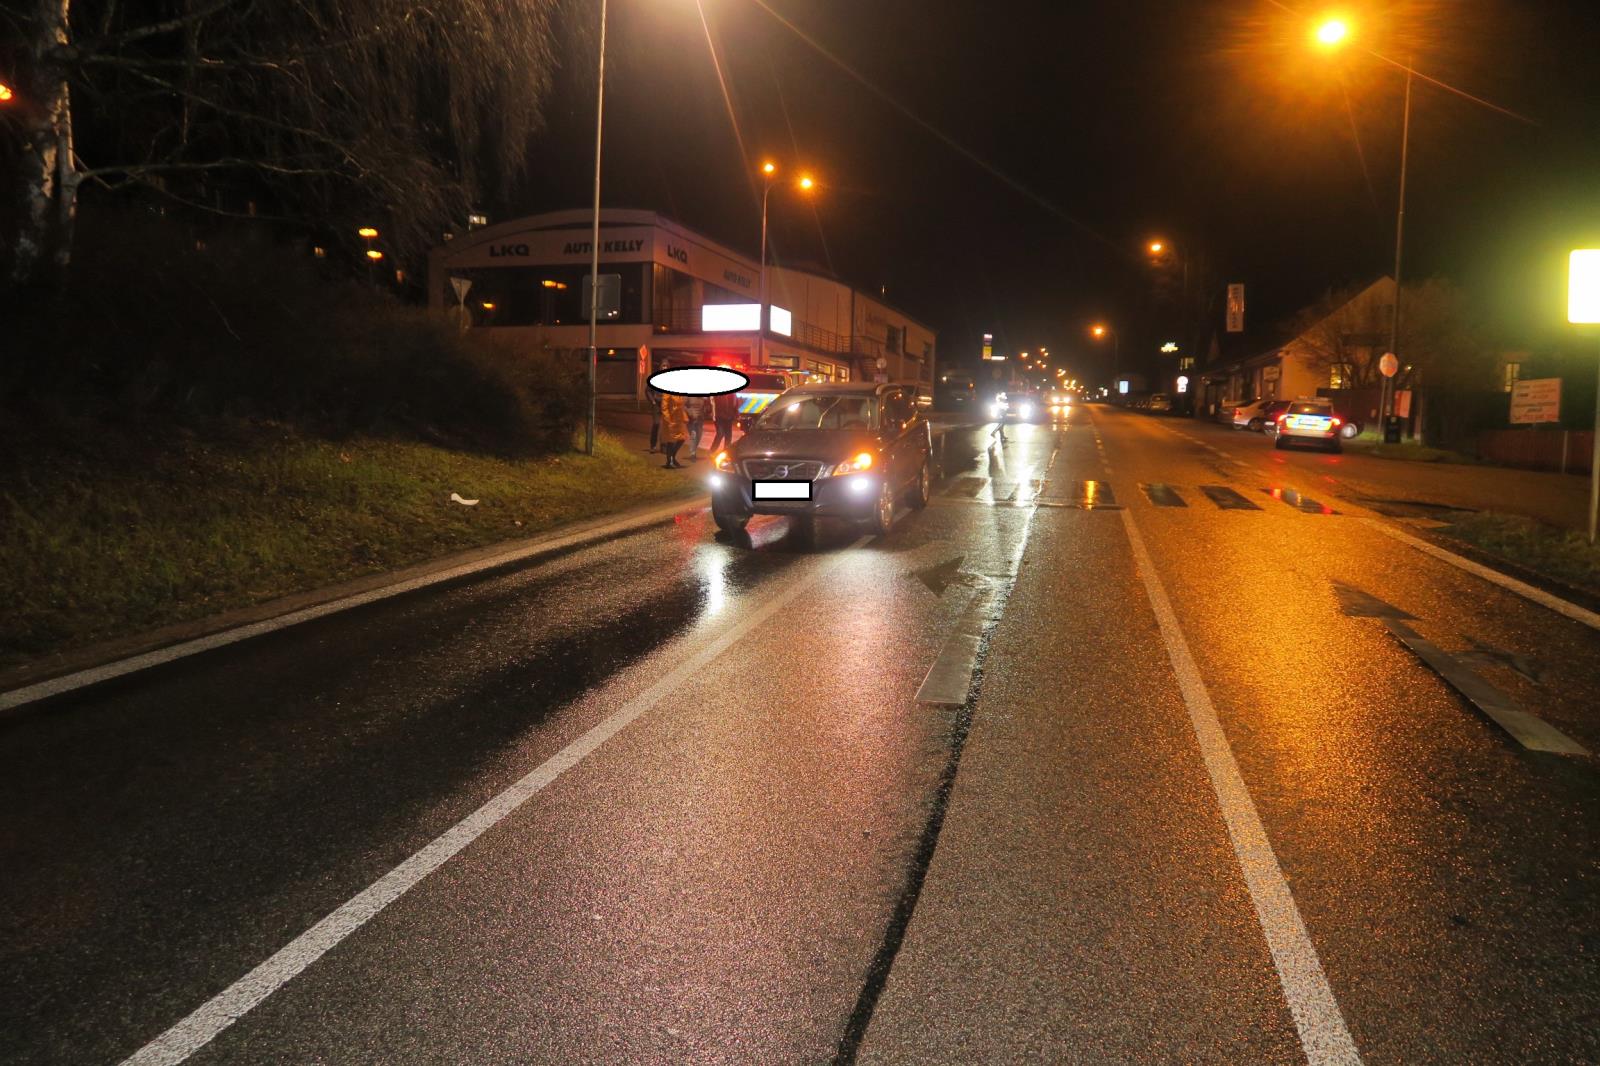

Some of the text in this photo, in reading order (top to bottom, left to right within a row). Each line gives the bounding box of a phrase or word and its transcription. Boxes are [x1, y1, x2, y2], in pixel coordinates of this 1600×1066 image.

[489, 244, 529, 257] LKQ
[604, 239, 644, 253] KELLY
[667, 244, 687, 264] LKQ
